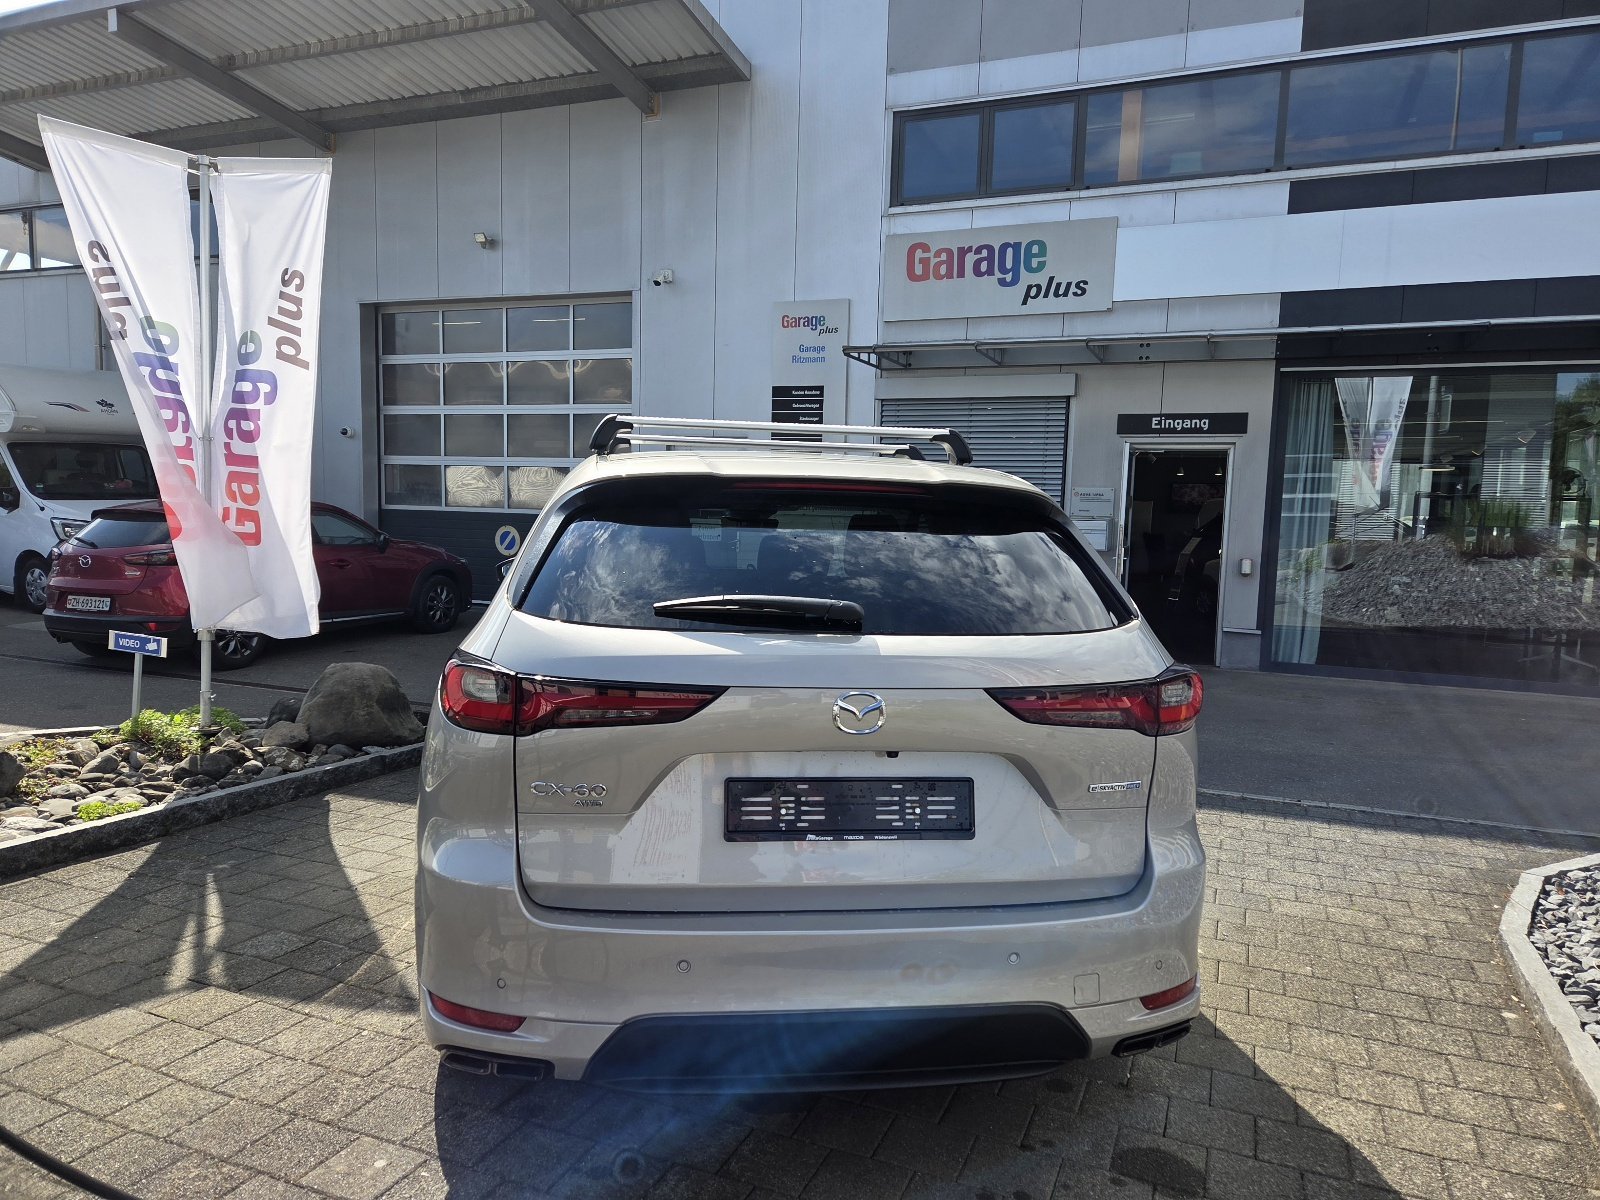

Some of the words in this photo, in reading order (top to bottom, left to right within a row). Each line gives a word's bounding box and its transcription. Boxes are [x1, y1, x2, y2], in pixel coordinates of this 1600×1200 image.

[906, 239, 1048, 288] Garage
[1020, 275, 1089, 306] plus
[266, 267, 310, 371] plus
[781, 314, 826, 331] Garage
[818, 325, 839, 337] plus
[798, 344, 826, 355] Garage
[791, 354, 826, 364] Ritzmann
[1151, 417, 1209, 431] Eingang
[221, 329, 279, 547] Garage
[118, 638, 140, 648] VIDEO
[530, 781, 608, 798] CX-60
